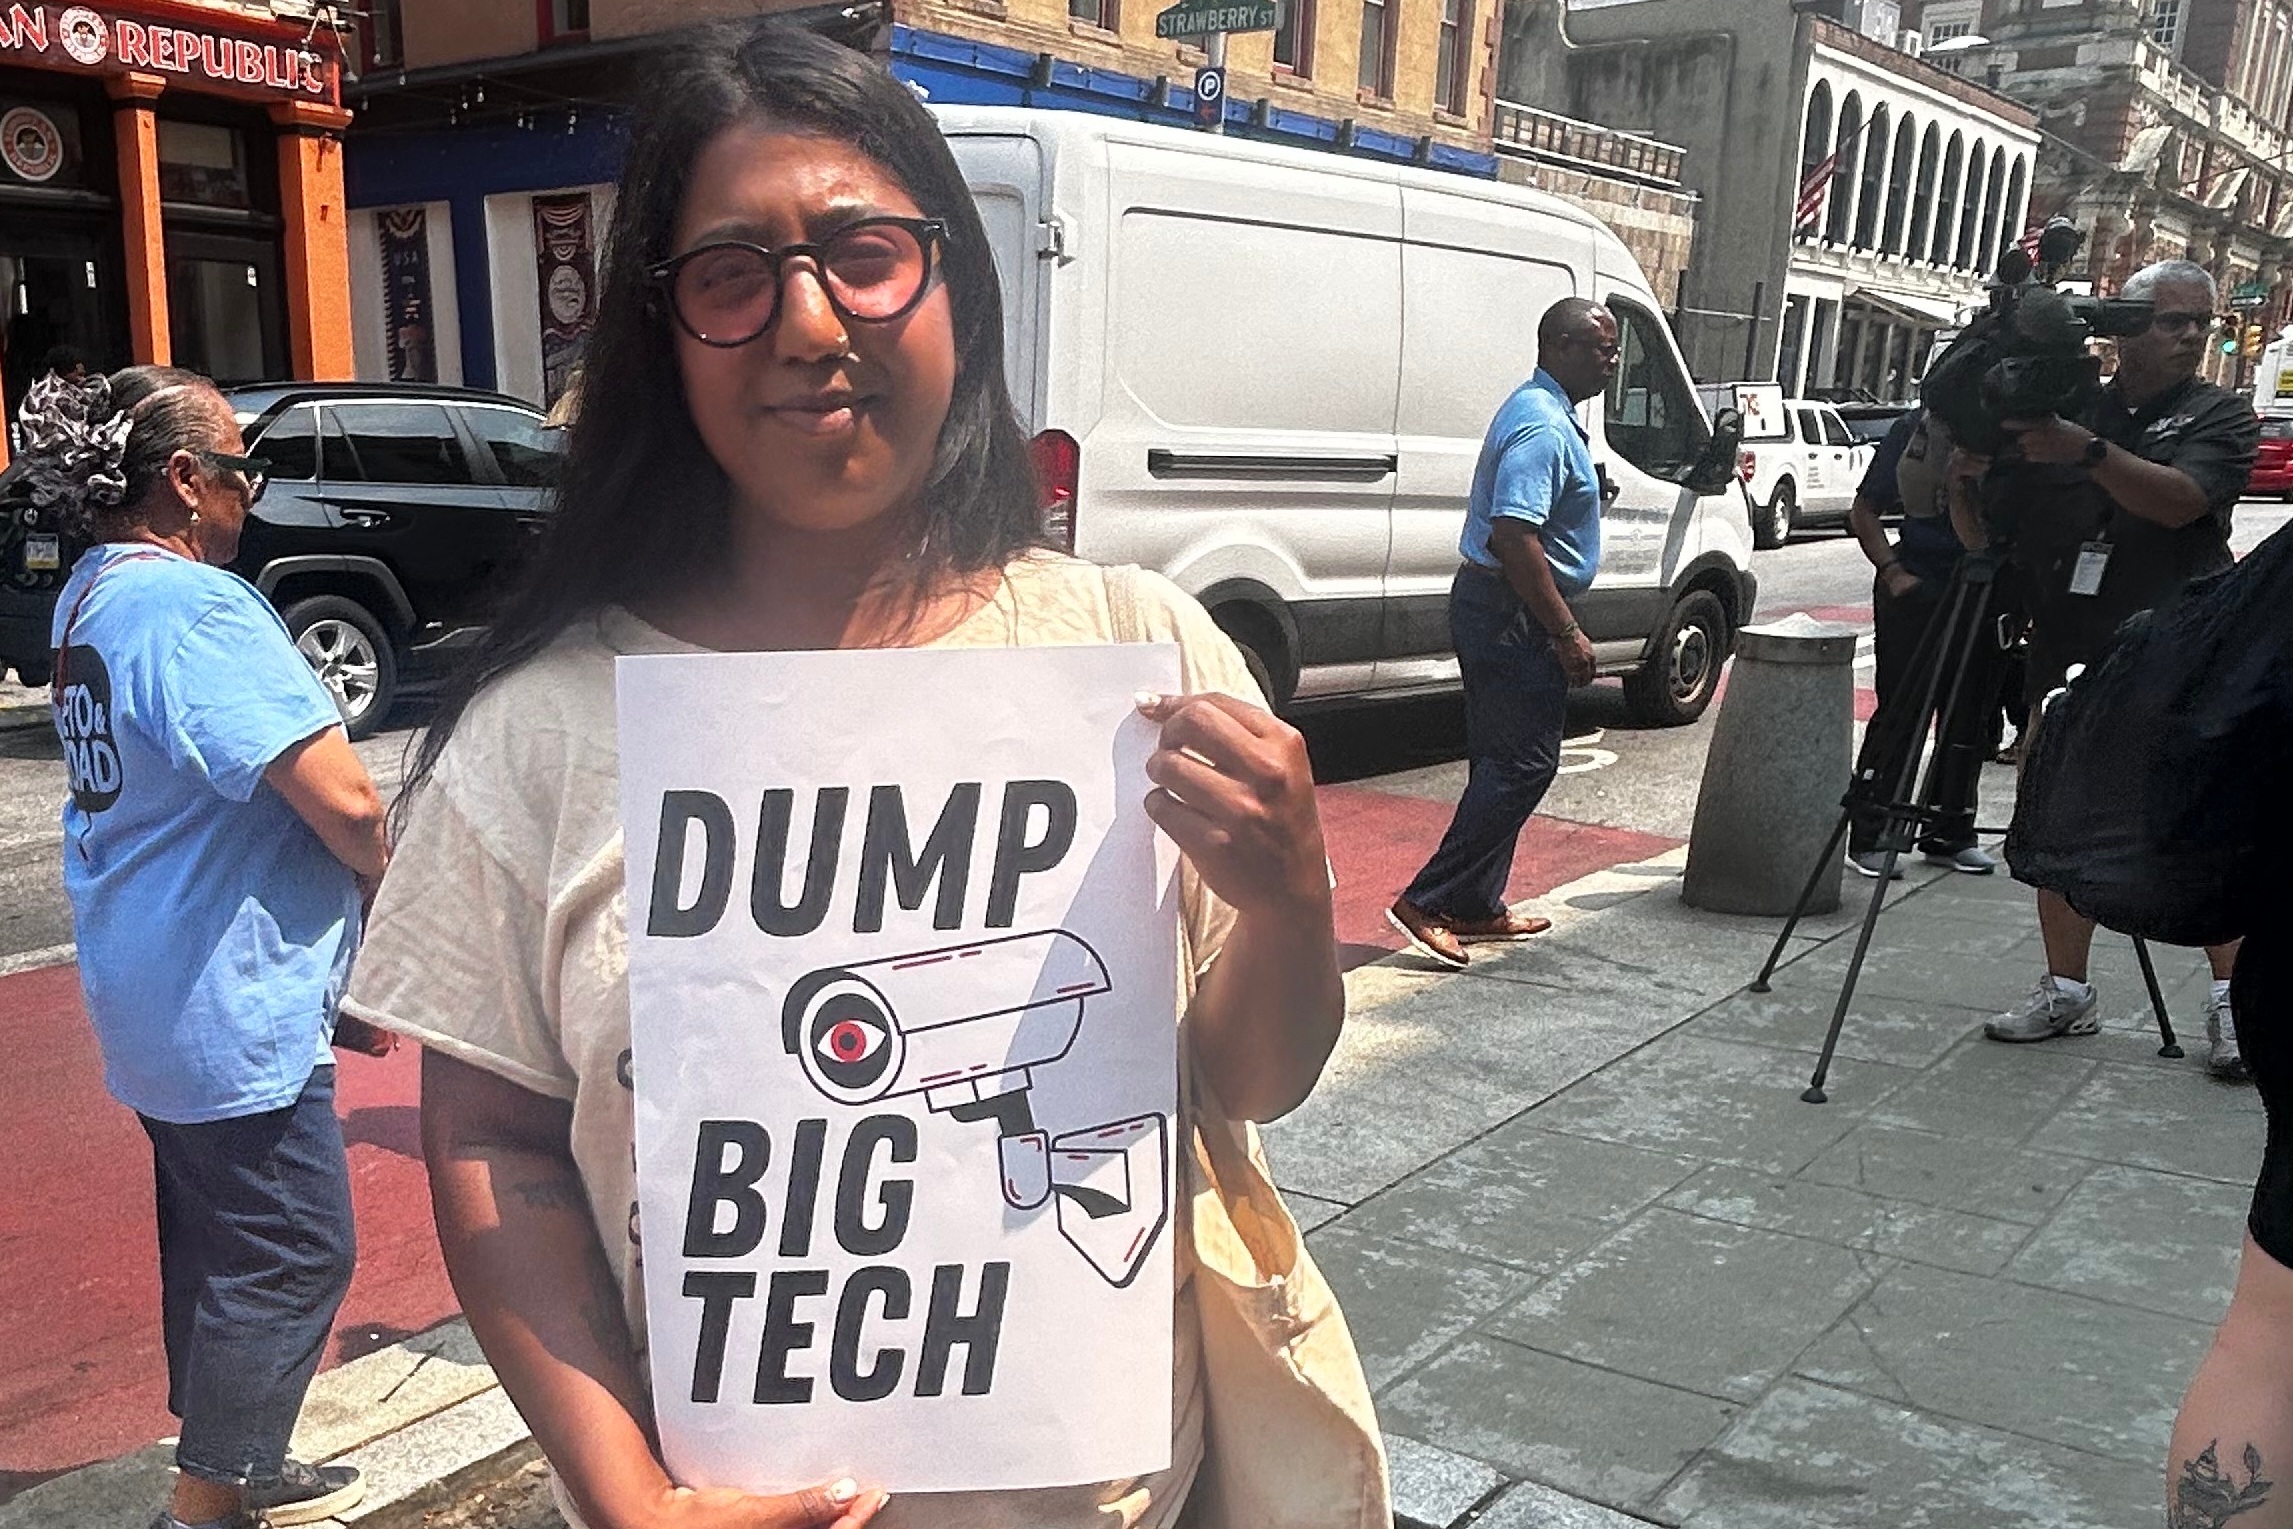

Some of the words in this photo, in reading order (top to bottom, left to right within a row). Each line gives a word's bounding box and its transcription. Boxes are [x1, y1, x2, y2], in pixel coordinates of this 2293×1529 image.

[116, 19, 324, 93] REPUBLIC
[1159, 5, 1258, 35] STRAWBERRY
[1260, 9, 1274, 25] ST
[645, 779, 1077, 938] DUMP
[681, 1114, 918, 1259] BIG
[681, 1261, 1011, 1405] TECH
